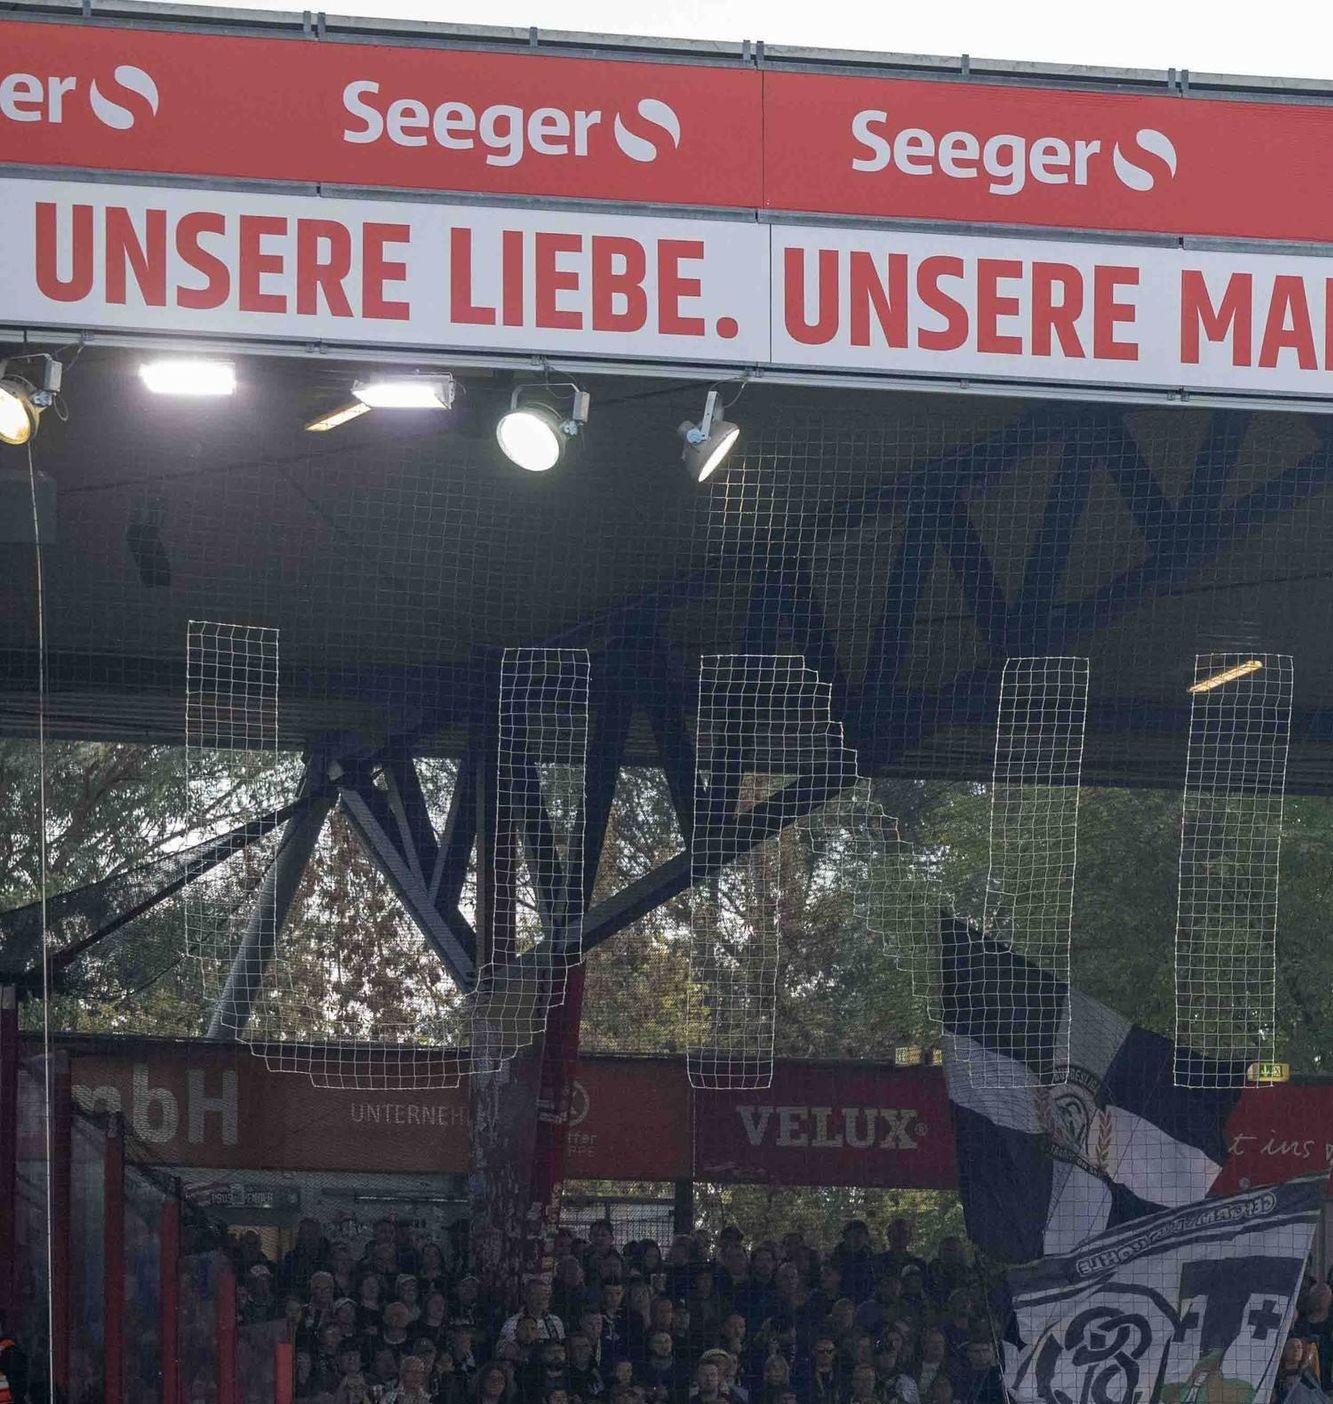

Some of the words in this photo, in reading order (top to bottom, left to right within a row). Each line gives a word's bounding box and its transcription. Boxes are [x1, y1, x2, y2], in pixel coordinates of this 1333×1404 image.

[343, 79, 601, 168] Seeger
[851, 109, 1101, 197] Seeger
[35, 202, 411, 322] UNSERE
[450, 226, 740, 340] LIEBE.
[783, 246, 1141, 363] UNSERE
